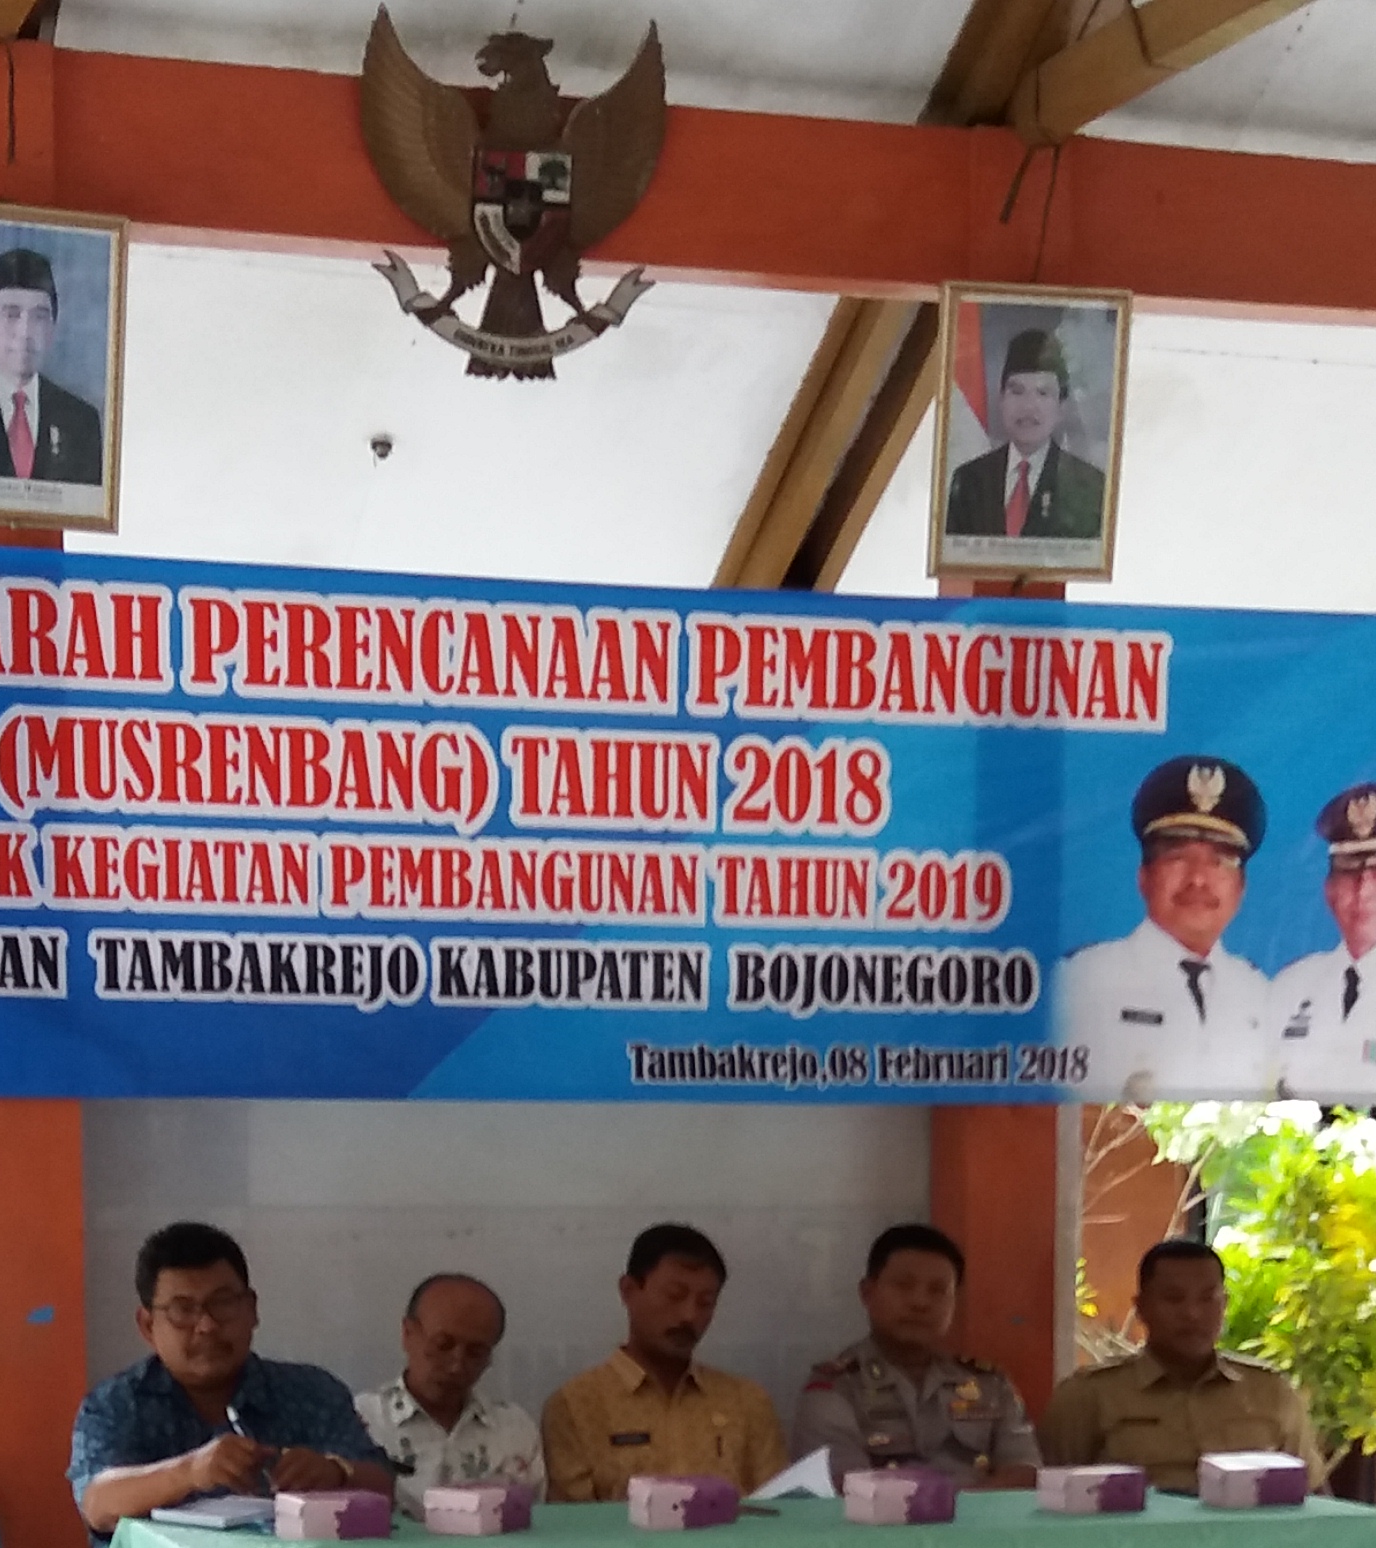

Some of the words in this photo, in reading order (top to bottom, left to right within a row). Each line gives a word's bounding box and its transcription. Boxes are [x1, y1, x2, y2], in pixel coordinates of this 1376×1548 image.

[189, 597, 672, 704] PERENCANAAN
[695, 622, 1164, 722] PEMBANGUNAN
[510, 735, 712, 821] TAHUN
[732, 744, 883, 826] 2018
[52, 834, 310, 905] KEGIATAN
[329, 843, 698, 915] PEMBANGUNAN
[717, 855, 869, 919] TAHUN
[886, 860, 1002, 921] 2019
[95, 937, 420, 1004] TAMBAKREJO
[437, 946, 704, 1003] KABUPATEN
[734, 952, 1035, 1012] BOJONEGORO
[877, 1043, 1013, 1085] Februari
[1016, 1043, 1089, 1085] 2018
